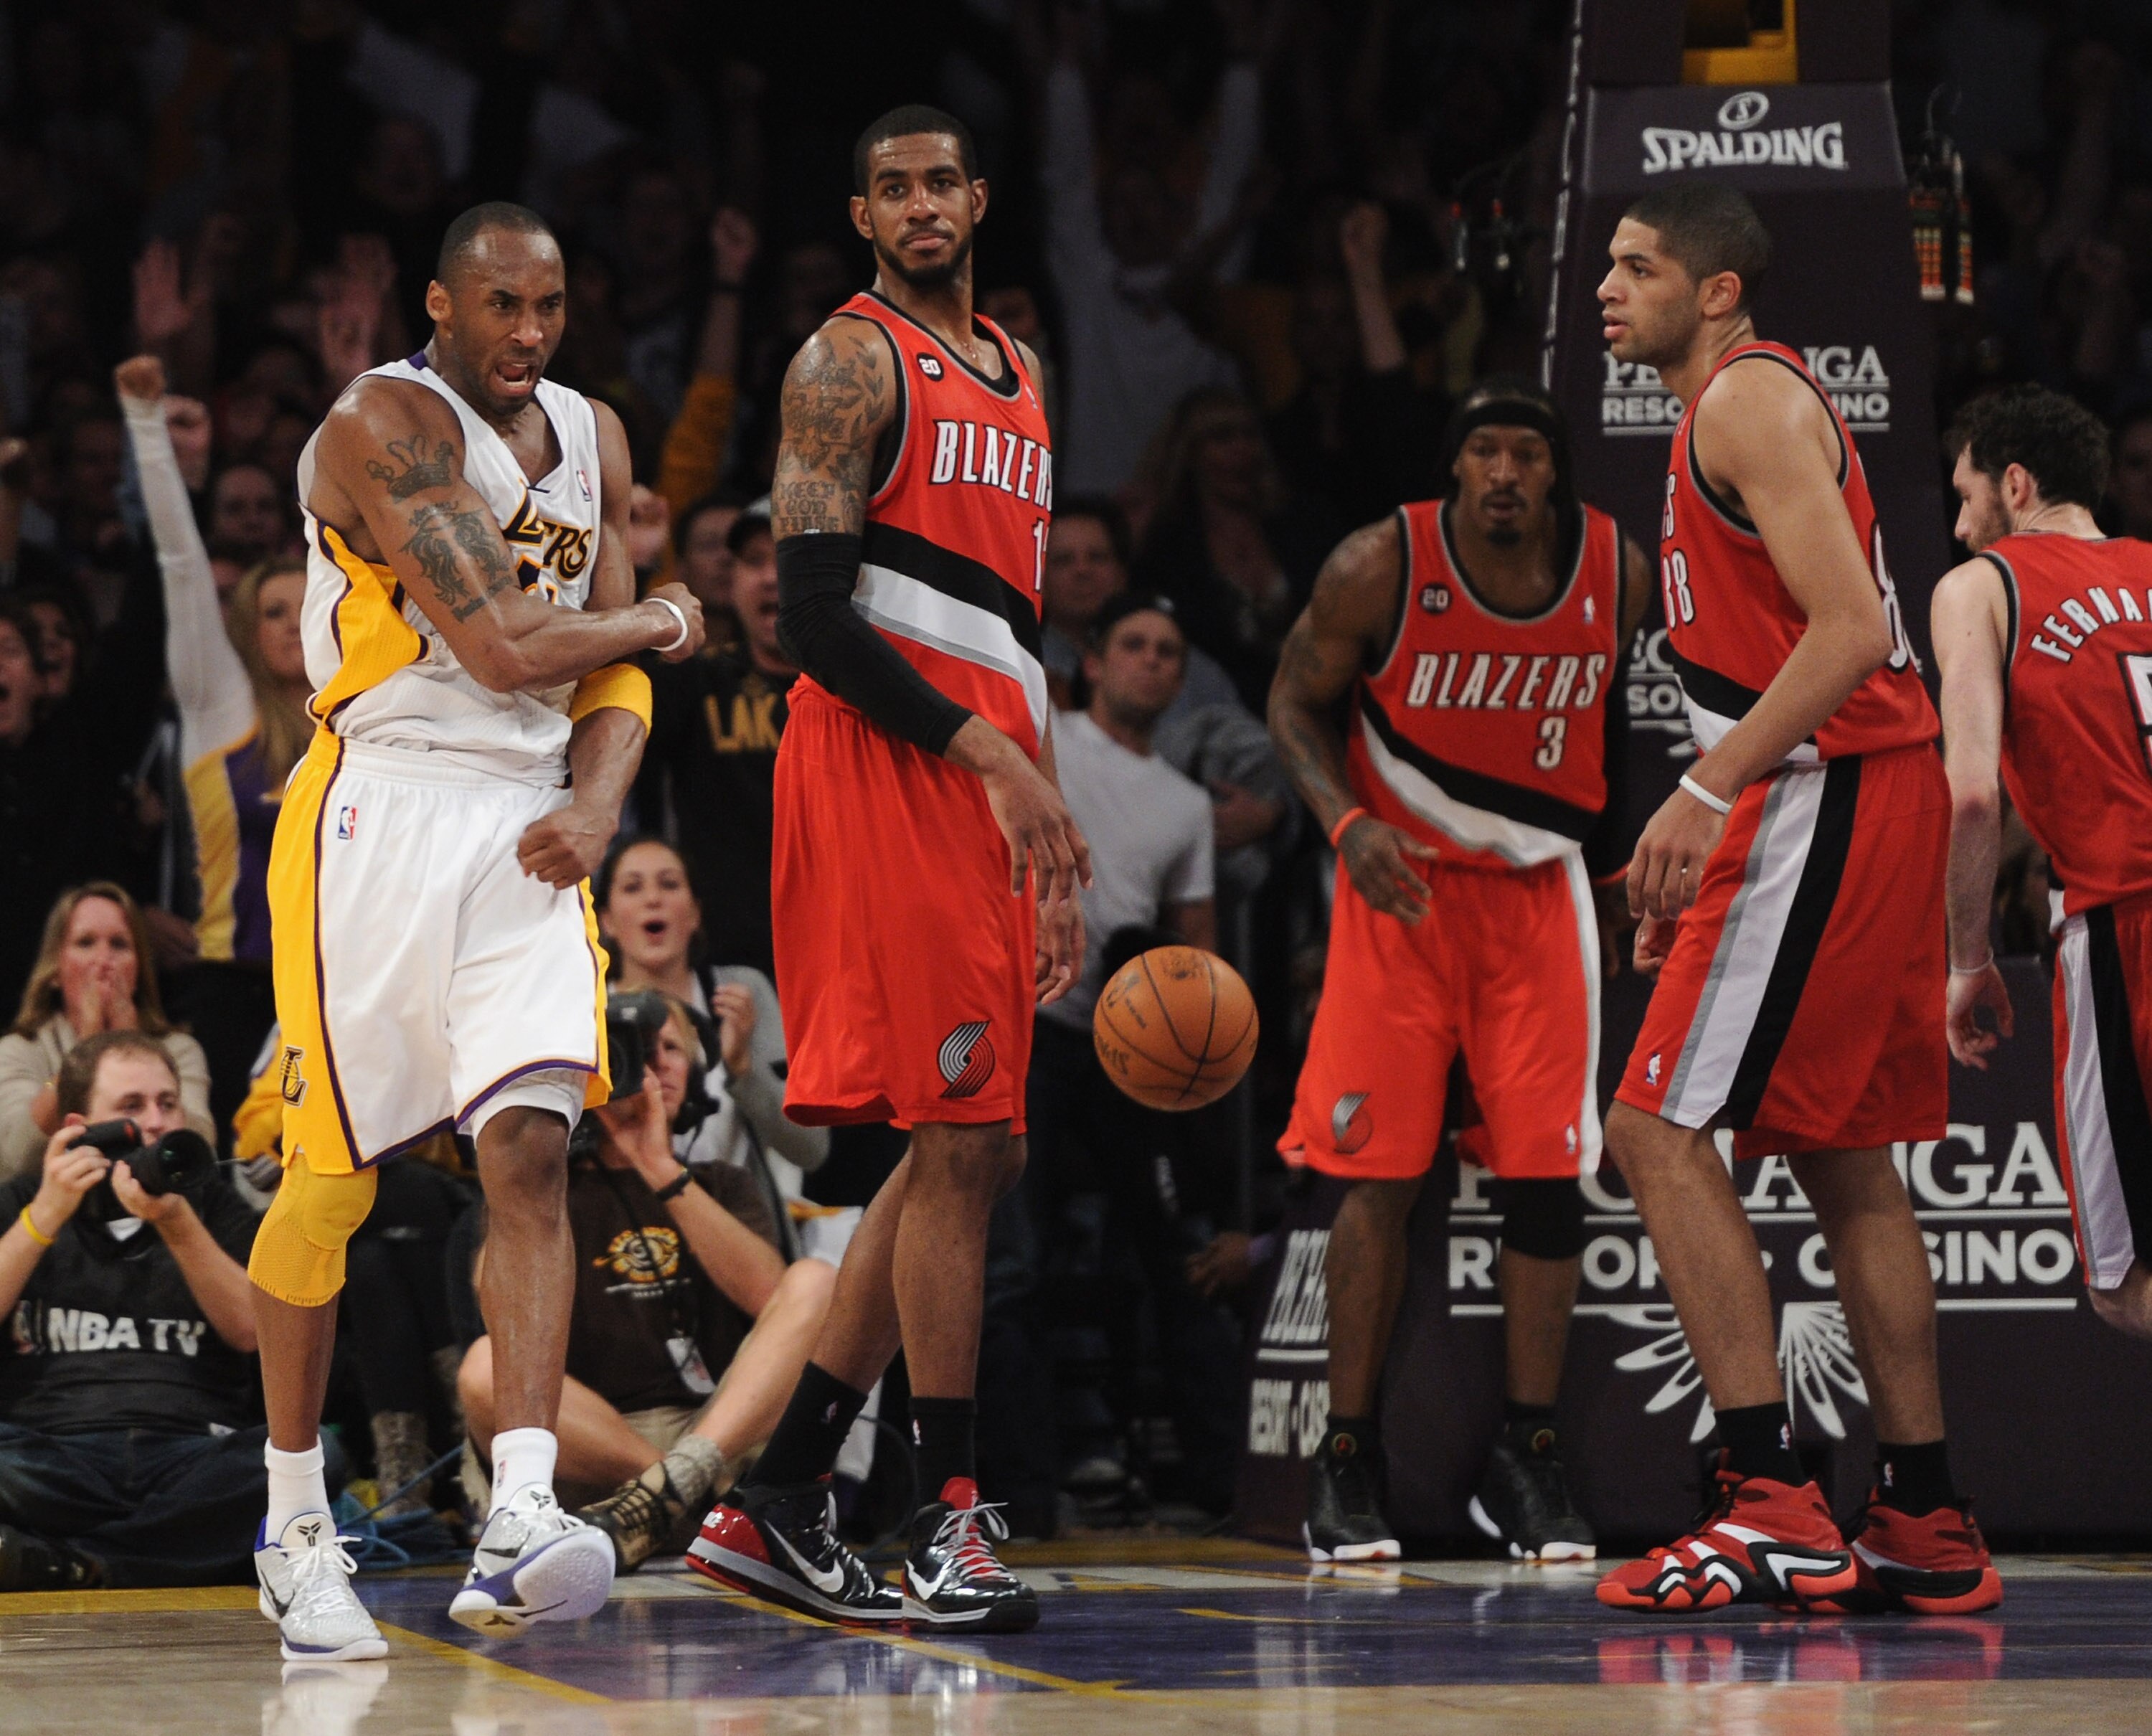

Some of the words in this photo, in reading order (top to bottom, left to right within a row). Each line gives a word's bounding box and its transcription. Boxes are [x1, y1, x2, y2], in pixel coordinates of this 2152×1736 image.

[1642, 122, 1846, 173] SPALDING
[918, 358, 941, 375] 20
[2031, 585, 2152, 663] FERNA
[1406, 651, 1607, 711] BLAZERS
[1536, 716, 1567, 770] 3
[47, 1307, 141, 1353] NBA
[146, 1318, 207, 1357] TV
